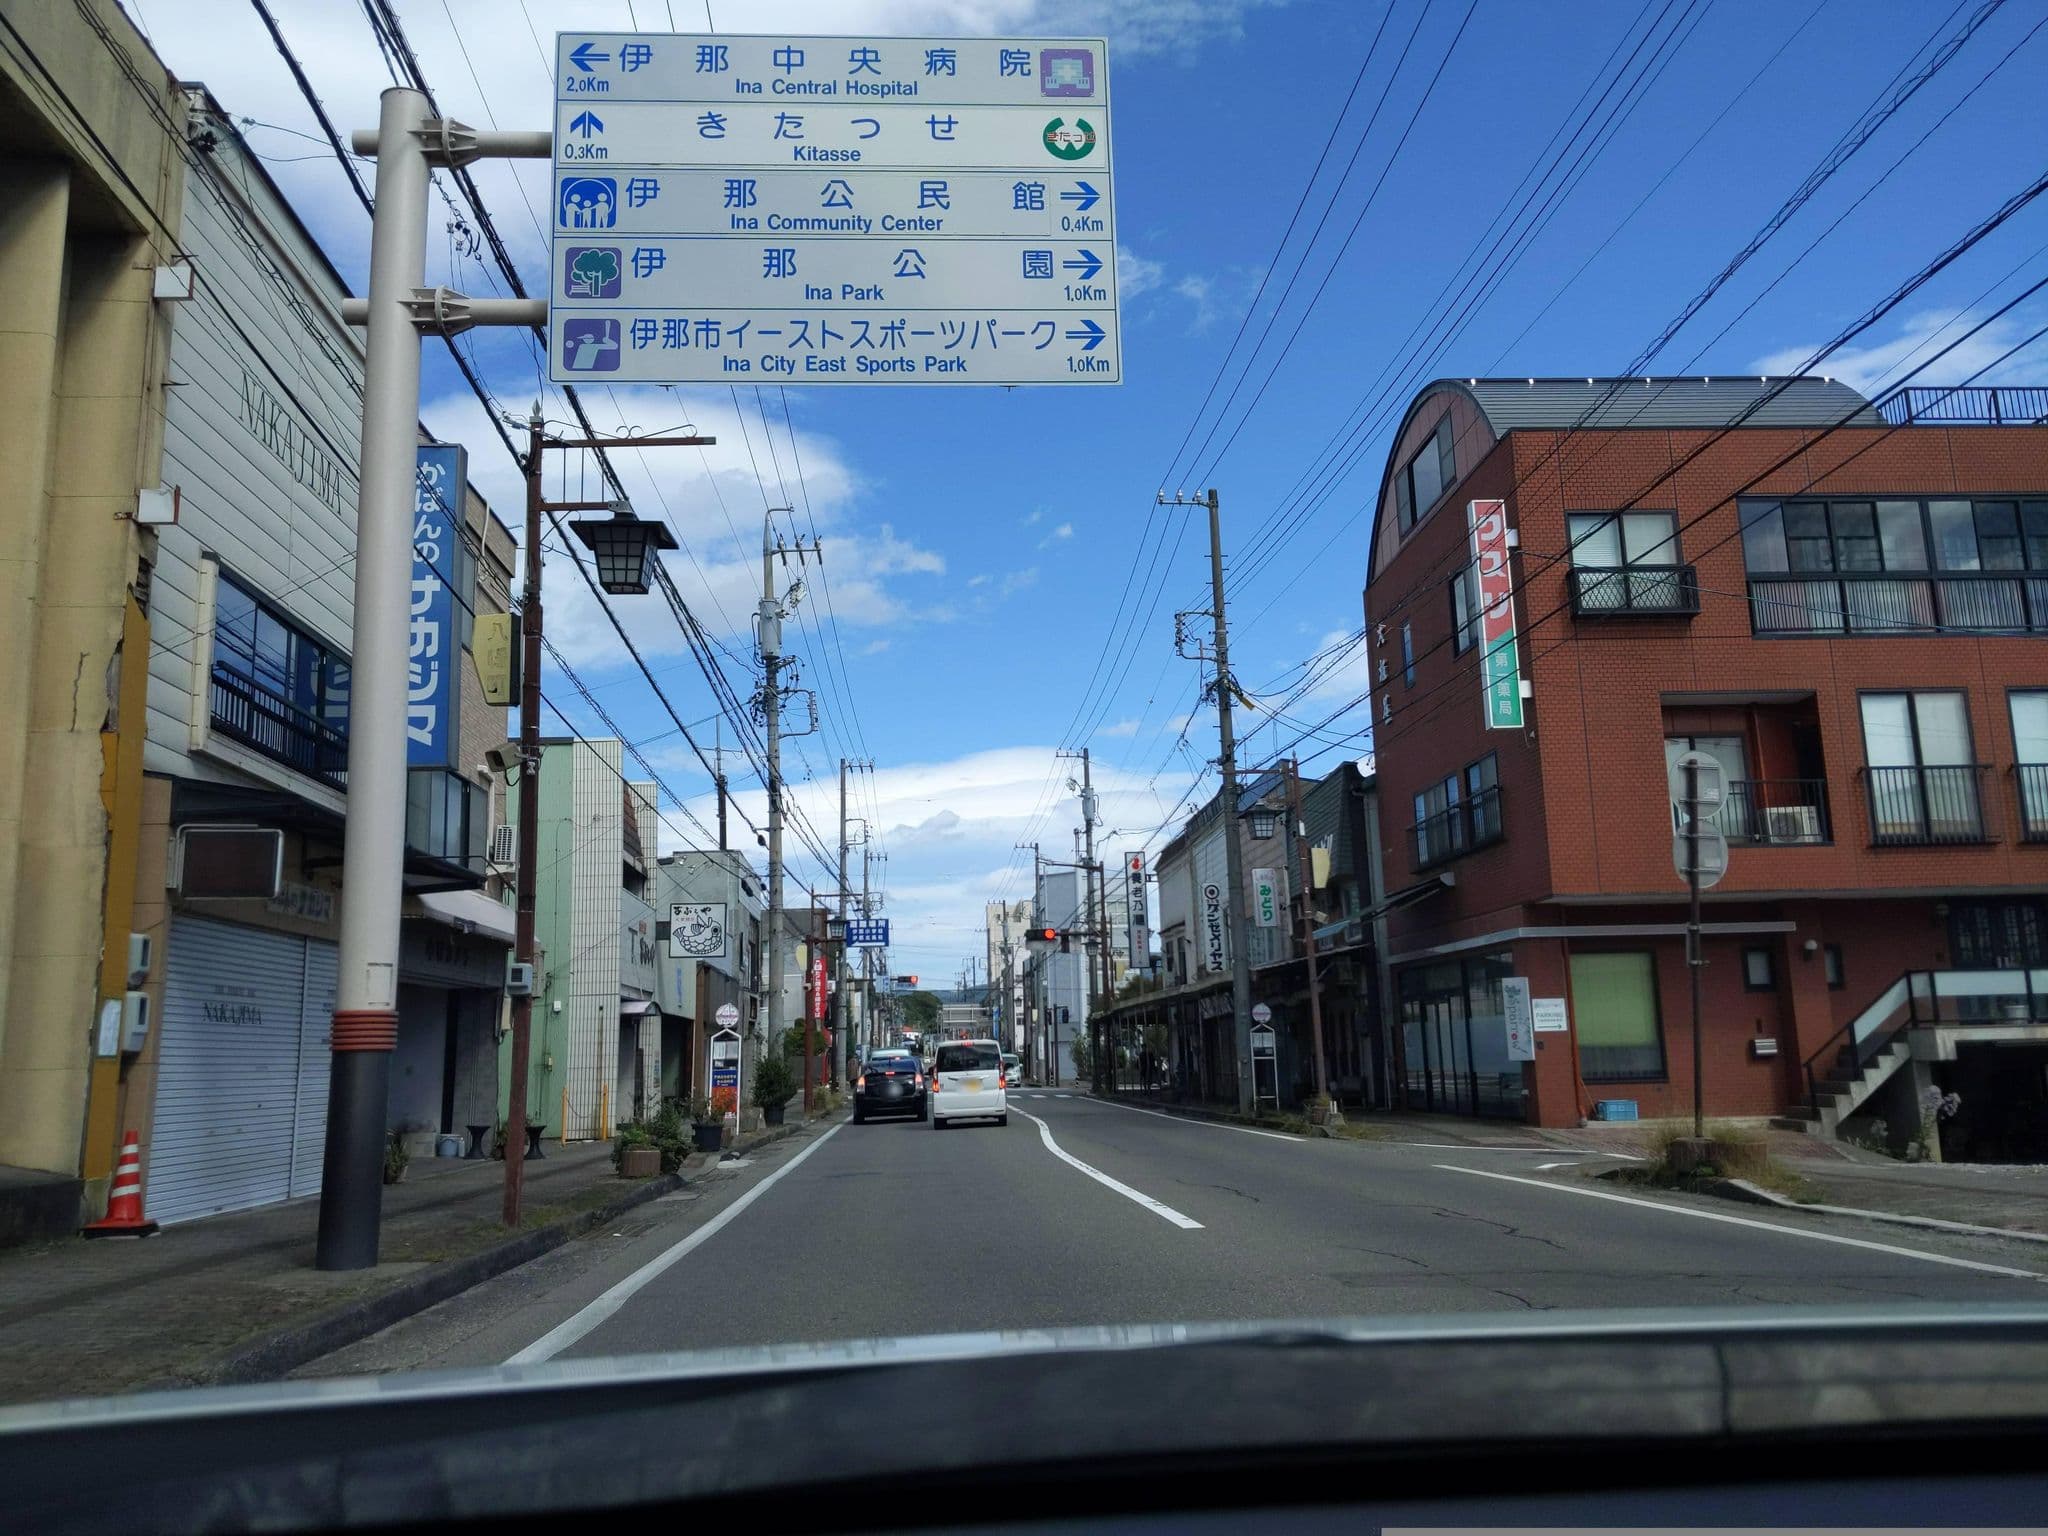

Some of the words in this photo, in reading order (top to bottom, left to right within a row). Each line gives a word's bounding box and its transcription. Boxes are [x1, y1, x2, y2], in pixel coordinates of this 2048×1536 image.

[618, 43, 1032, 78] 伊那中央病院
[566, 76, 610, 93] 2.0Km
[735, 79, 763, 93] Ina
[771, 79, 837, 95] Central
[845, 81, 919, 97] Hospital
[564, 144, 608, 160] 0.3Km
[793, 146, 861, 161] Kitasse
[625, 176, 1046, 212] 伊那公民館
[730, 214, 760, 230] Ina
[766, 215, 873, 233] Community
[880, 215, 943, 231] Center
[1061, 216, 1104, 232] 0.4Km
[631, 246, 1056, 280] 伊那公園
[804, 285, 832, 300] Ina
[841, 284, 884, 300] Park
[1064, 286, 1107, 301] 1.0Km
[630, 317, 1057, 350] 伊那市イーストスポーツパーク
[723, 356, 752, 372] Ina
[760, 355, 796, 374] City
[804, 355, 847, 373] East
[856, 355, 916, 375] Sports
[925, 355, 967, 373] Park
[1067, 356, 1110, 373] 1.0Km
[239, 370, 342, 516] NAKAJIMA
[1259, 885, 1273, 922] みどり
